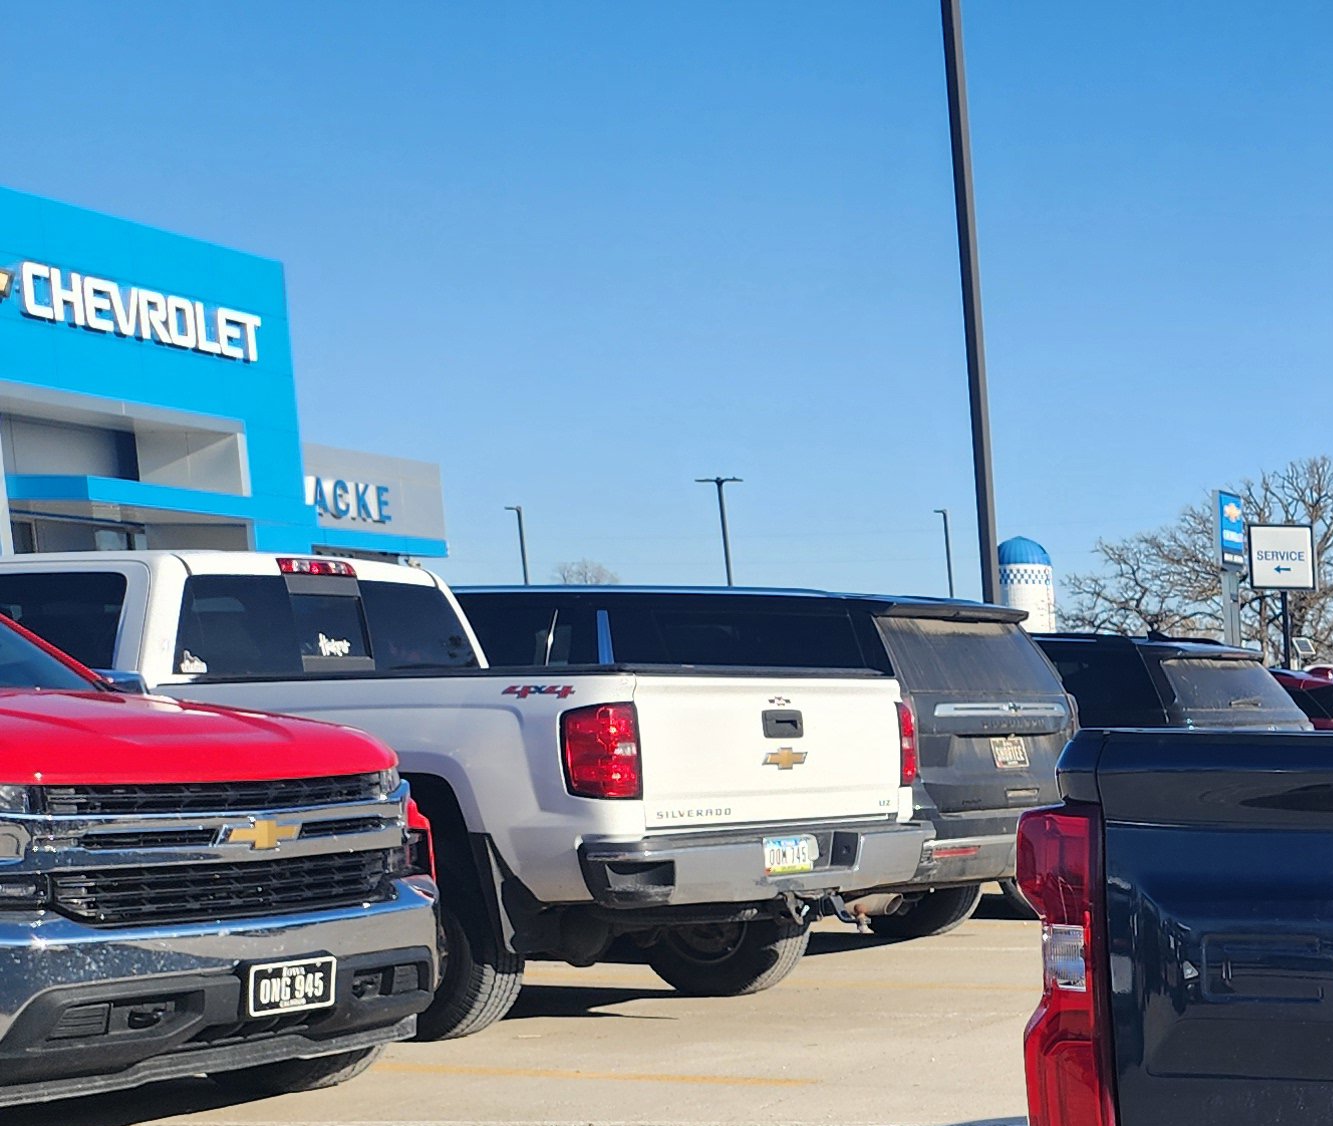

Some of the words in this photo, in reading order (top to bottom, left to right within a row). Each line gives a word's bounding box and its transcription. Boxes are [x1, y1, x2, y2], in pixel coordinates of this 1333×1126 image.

[22, 261, 261, 362] CHEVROLET
[1256, 551, 1305, 561] SERVICE
[656, 808, 732, 819] SILVERADO
[260, 976, 291, 1005] ONG
[294, 972, 324, 999] 945
